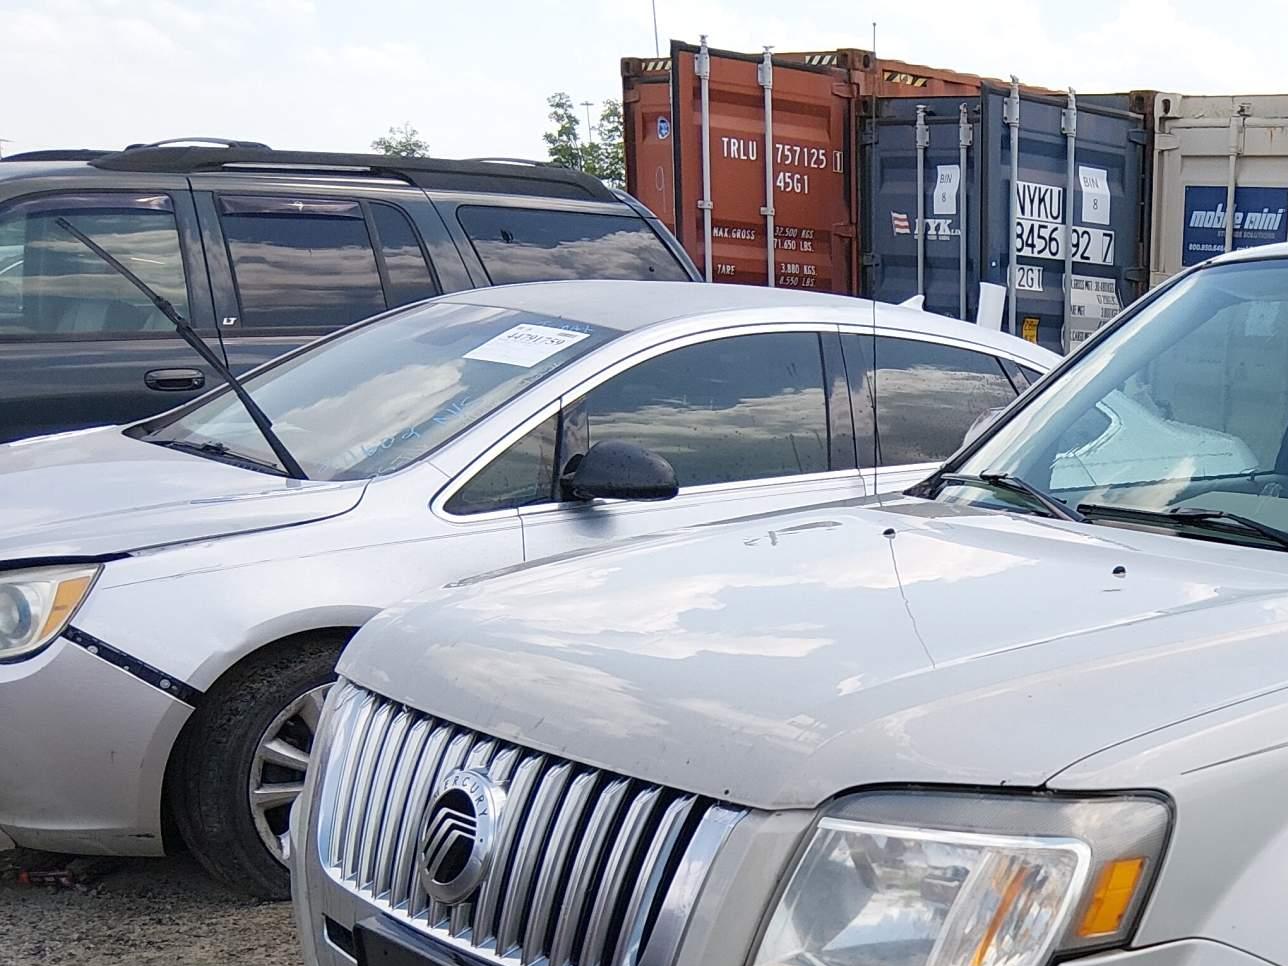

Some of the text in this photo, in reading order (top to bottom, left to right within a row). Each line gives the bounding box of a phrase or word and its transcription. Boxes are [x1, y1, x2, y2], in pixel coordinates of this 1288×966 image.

[722, 137, 757, 160] TRLU
[775, 143, 827, 169] 757125
[776, 171, 809, 194] 45G1
[939, 174, 953, 184] BIN
[1083, 176, 1099, 189] BIN
[1016, 183, 1062, 220] NYKU
[1092, 198, 1099, 210] 8
[1243, 207, 1283, 230] mini
[774, 239, 815, 252] 71.650 LBS.
[1071, 228, 1092, 261] 92
[1102, 232, 1114, 263] 7
[717, 263, 735, 275] TARE
[223, 317, 238, 326] LT
[433, 775, 489, 817] MERCURY
